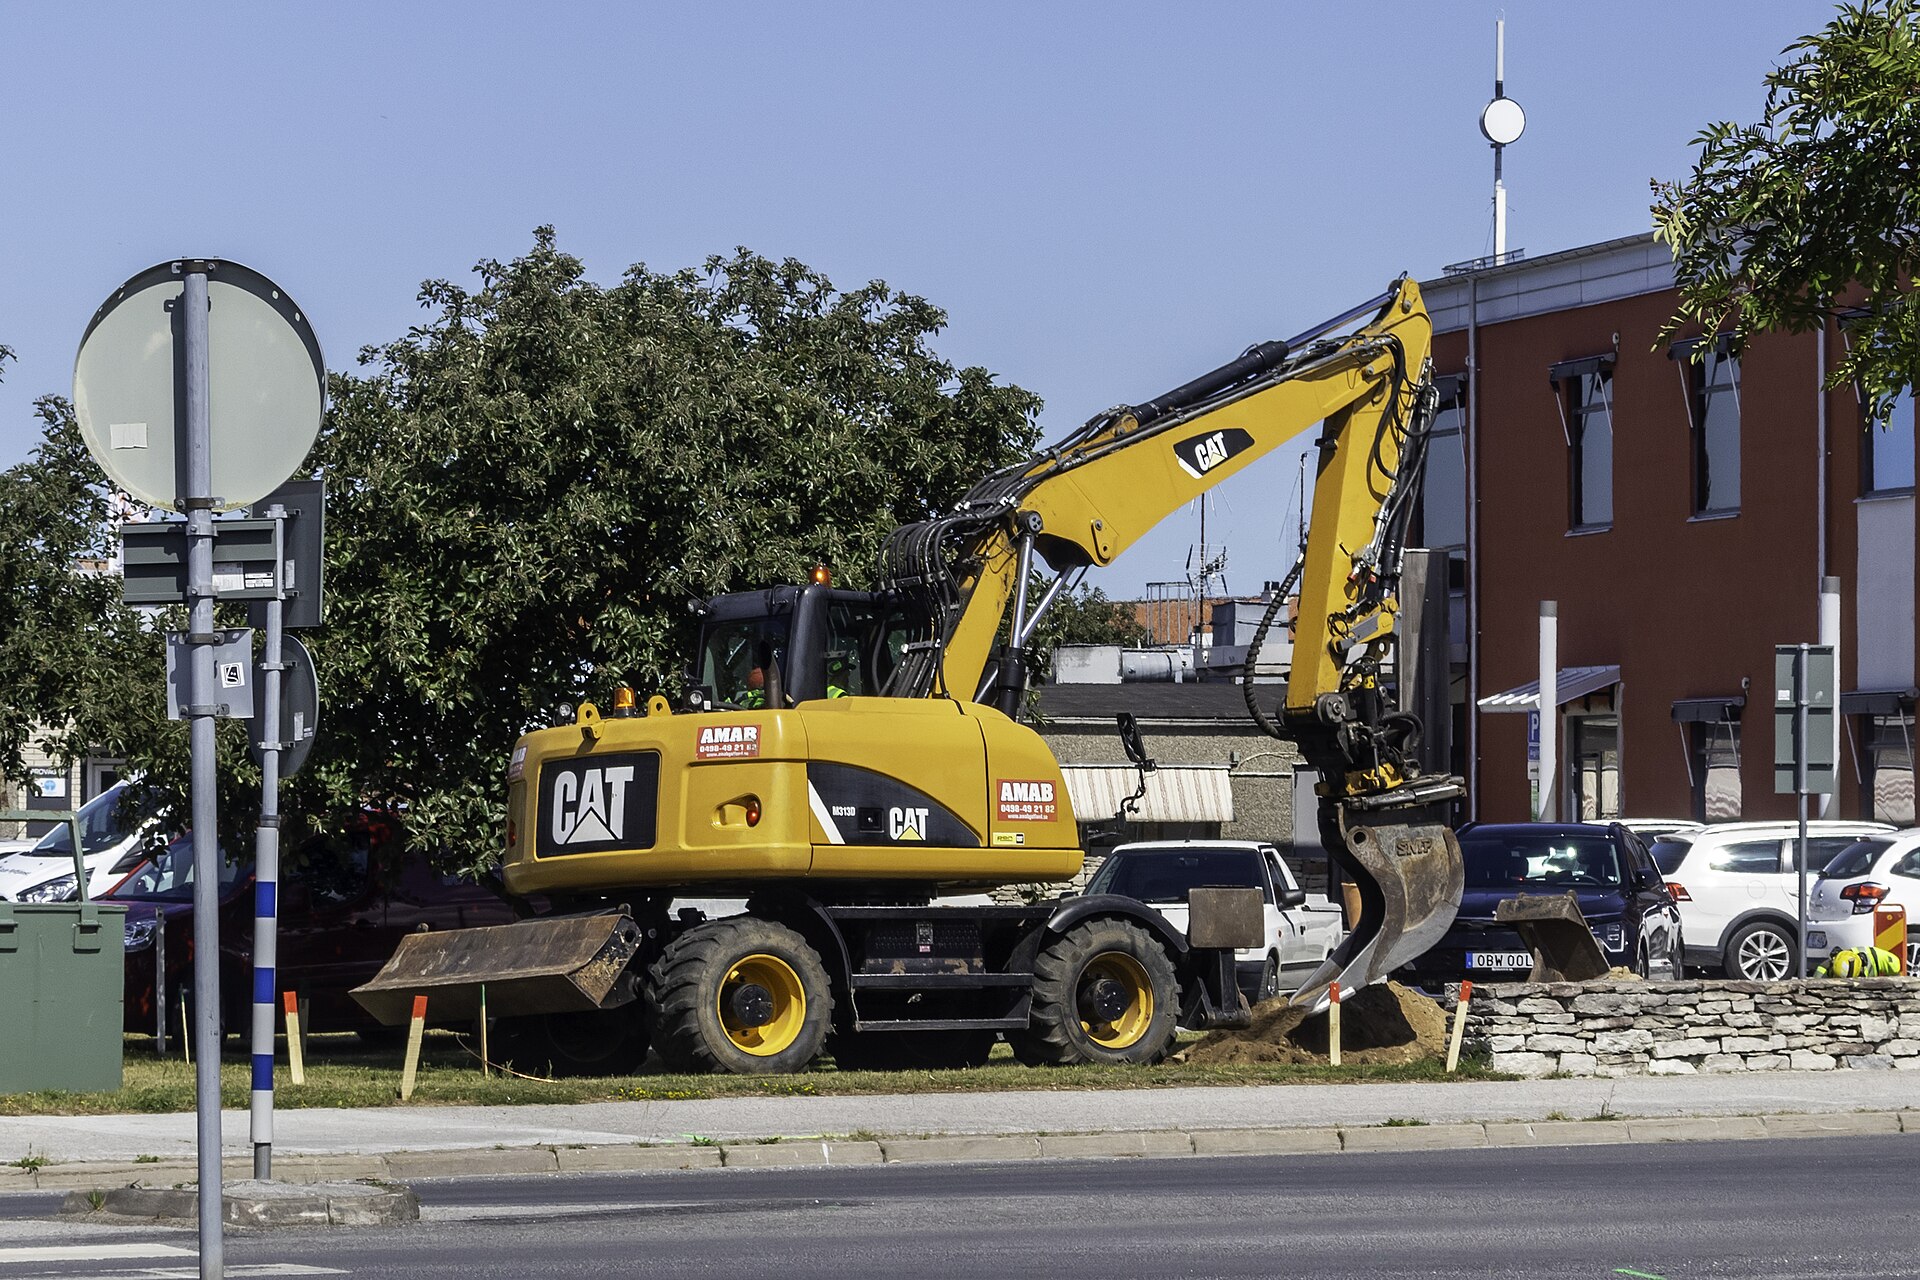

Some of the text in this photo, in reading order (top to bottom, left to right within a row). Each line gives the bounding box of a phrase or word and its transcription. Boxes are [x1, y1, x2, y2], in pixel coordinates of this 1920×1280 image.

[1195, 431, 1228, 471] CAT
[552, 766, 634, 845] CAT
[1000, 782, 1054, 802] AMAB
[832, 805, 929, 841] M313D CAT
[1000, 804, 1055, 814] 0498-49 21 82
[1477, 954, 1503, 967] OBW
